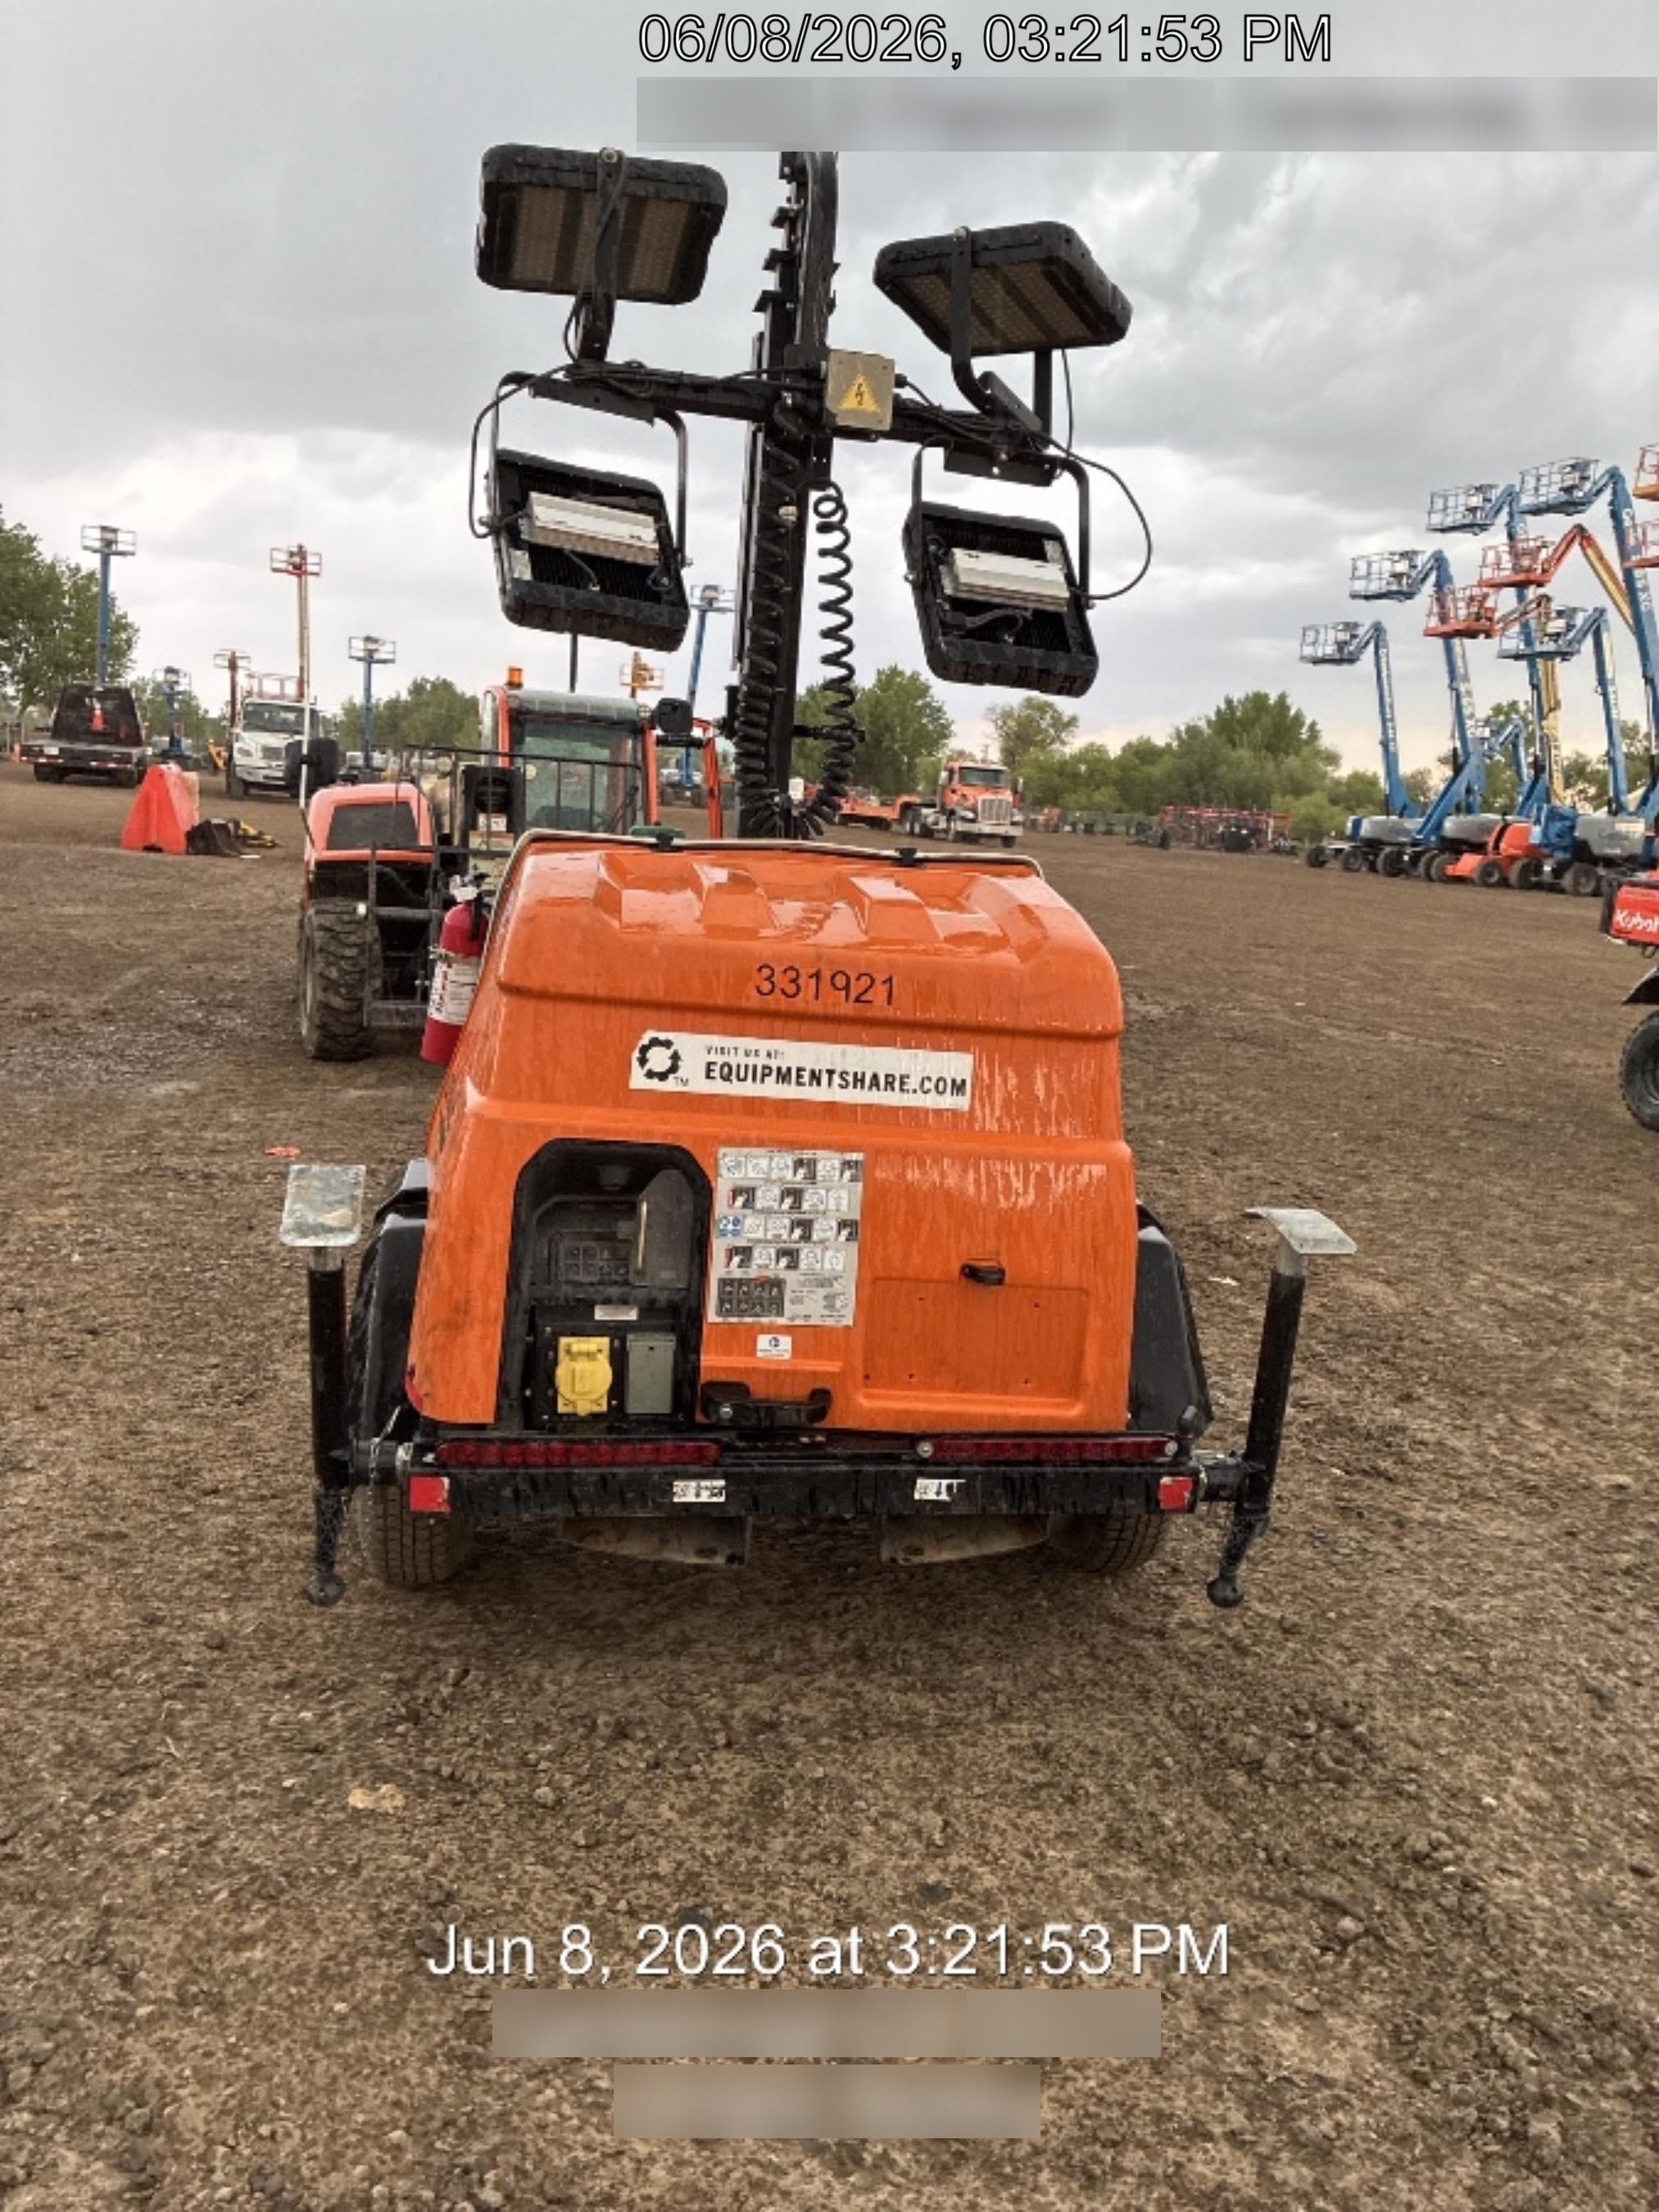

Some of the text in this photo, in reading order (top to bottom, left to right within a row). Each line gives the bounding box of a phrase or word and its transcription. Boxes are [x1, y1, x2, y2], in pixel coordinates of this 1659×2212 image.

[755, 963, 895, 1007] 331921
[705, 1044, 739, 1058] VISIT
[744, 1048, 760, 1058] US
[704, 1060, 967, 1098] EQUIPMENTSHARE.COM
